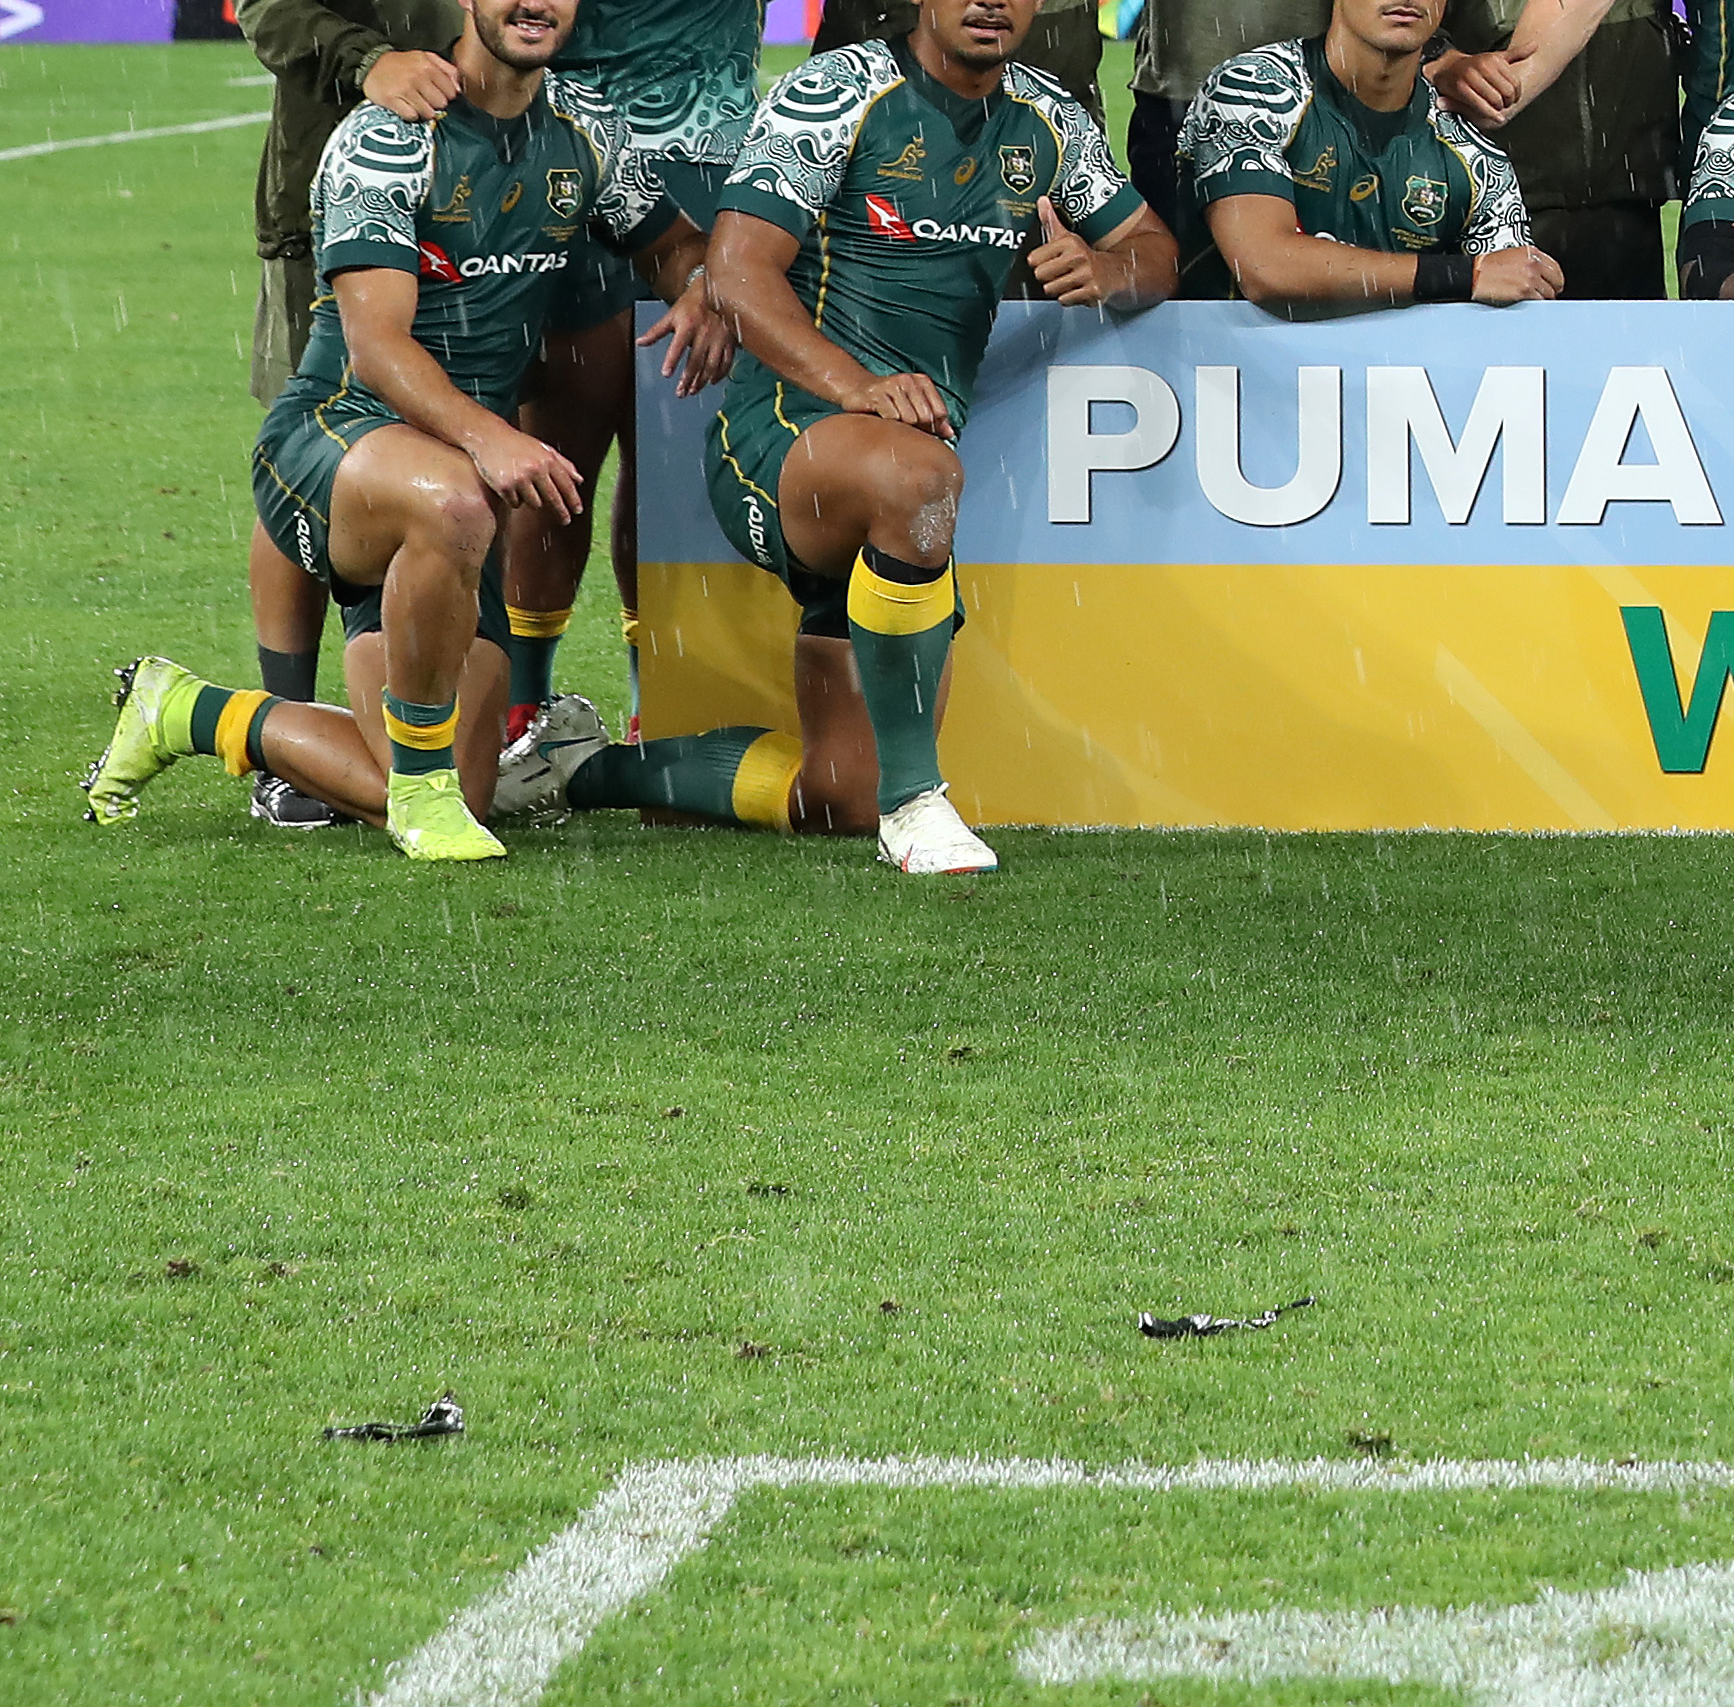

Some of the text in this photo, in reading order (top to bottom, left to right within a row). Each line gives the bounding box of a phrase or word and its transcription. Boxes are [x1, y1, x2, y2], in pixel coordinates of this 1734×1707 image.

[912, 218, 1027, 250] QANTAS
[459, 250, 569, 278] QANTAS
[1046, 364, 1722, 527] PUMA
